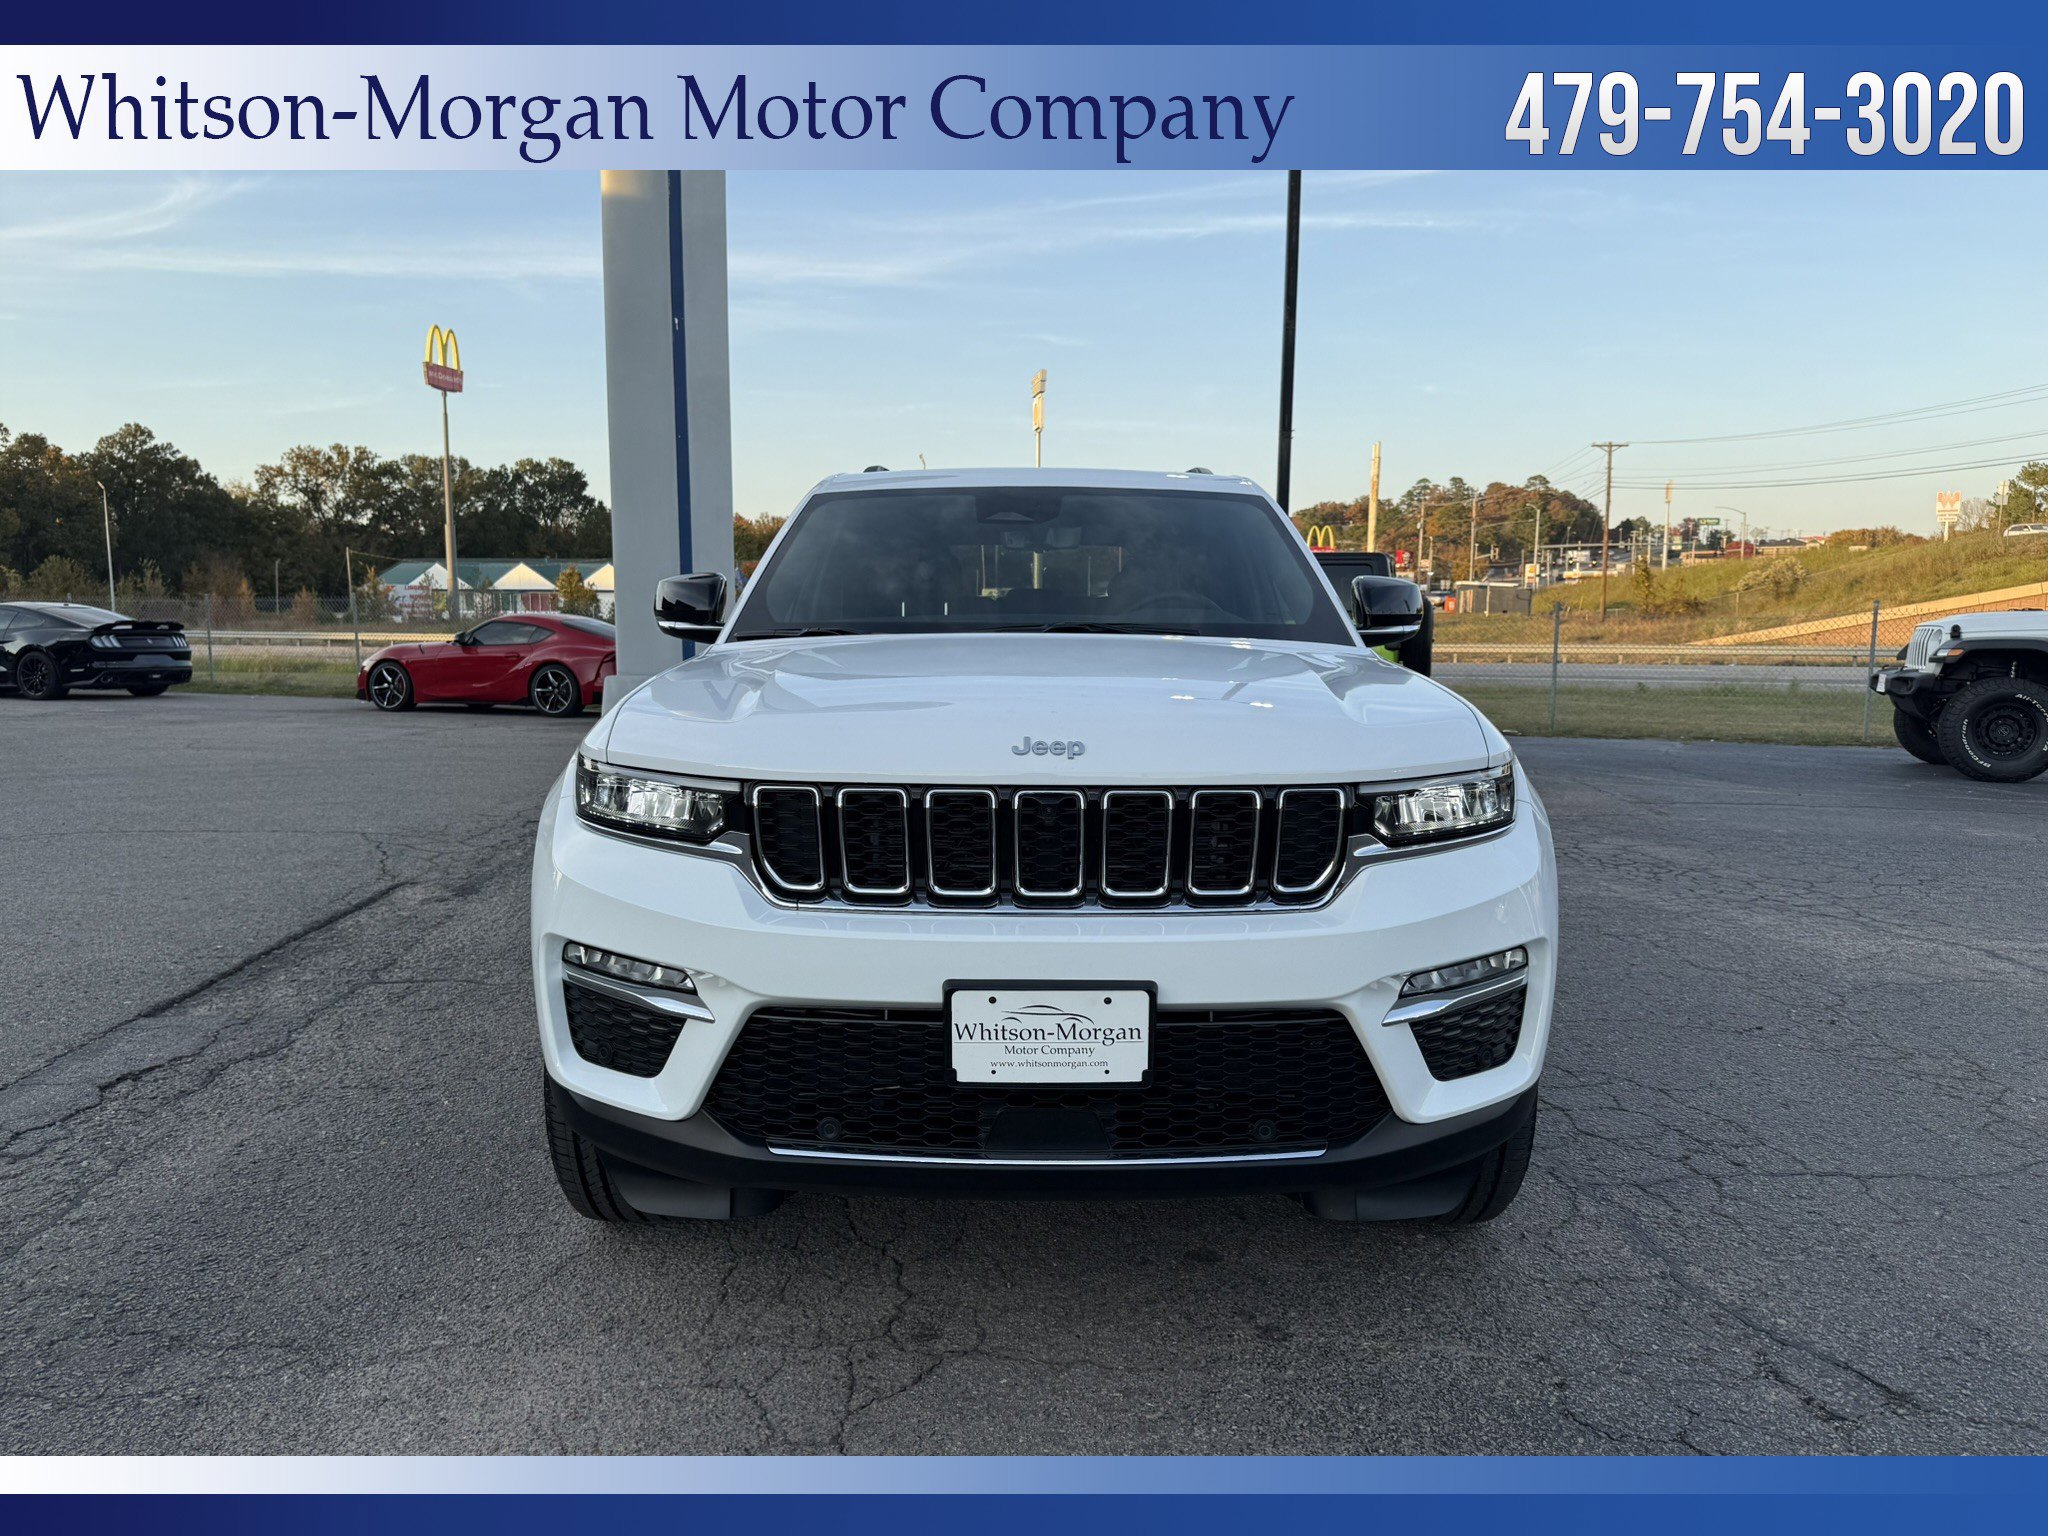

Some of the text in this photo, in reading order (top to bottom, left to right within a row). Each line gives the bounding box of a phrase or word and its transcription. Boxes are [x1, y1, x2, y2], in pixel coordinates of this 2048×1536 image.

[1011, 735, 1086, 760] Jeep
[1961, 718, 1992, 768] BFGoodrich
[954, 1021, 1142, 1046] Whitson-Morgan
[1004, 1044, 1096, 1058] Motor Company
[990, 1059, 1109, 1069] www.whitsonmorgan.com
